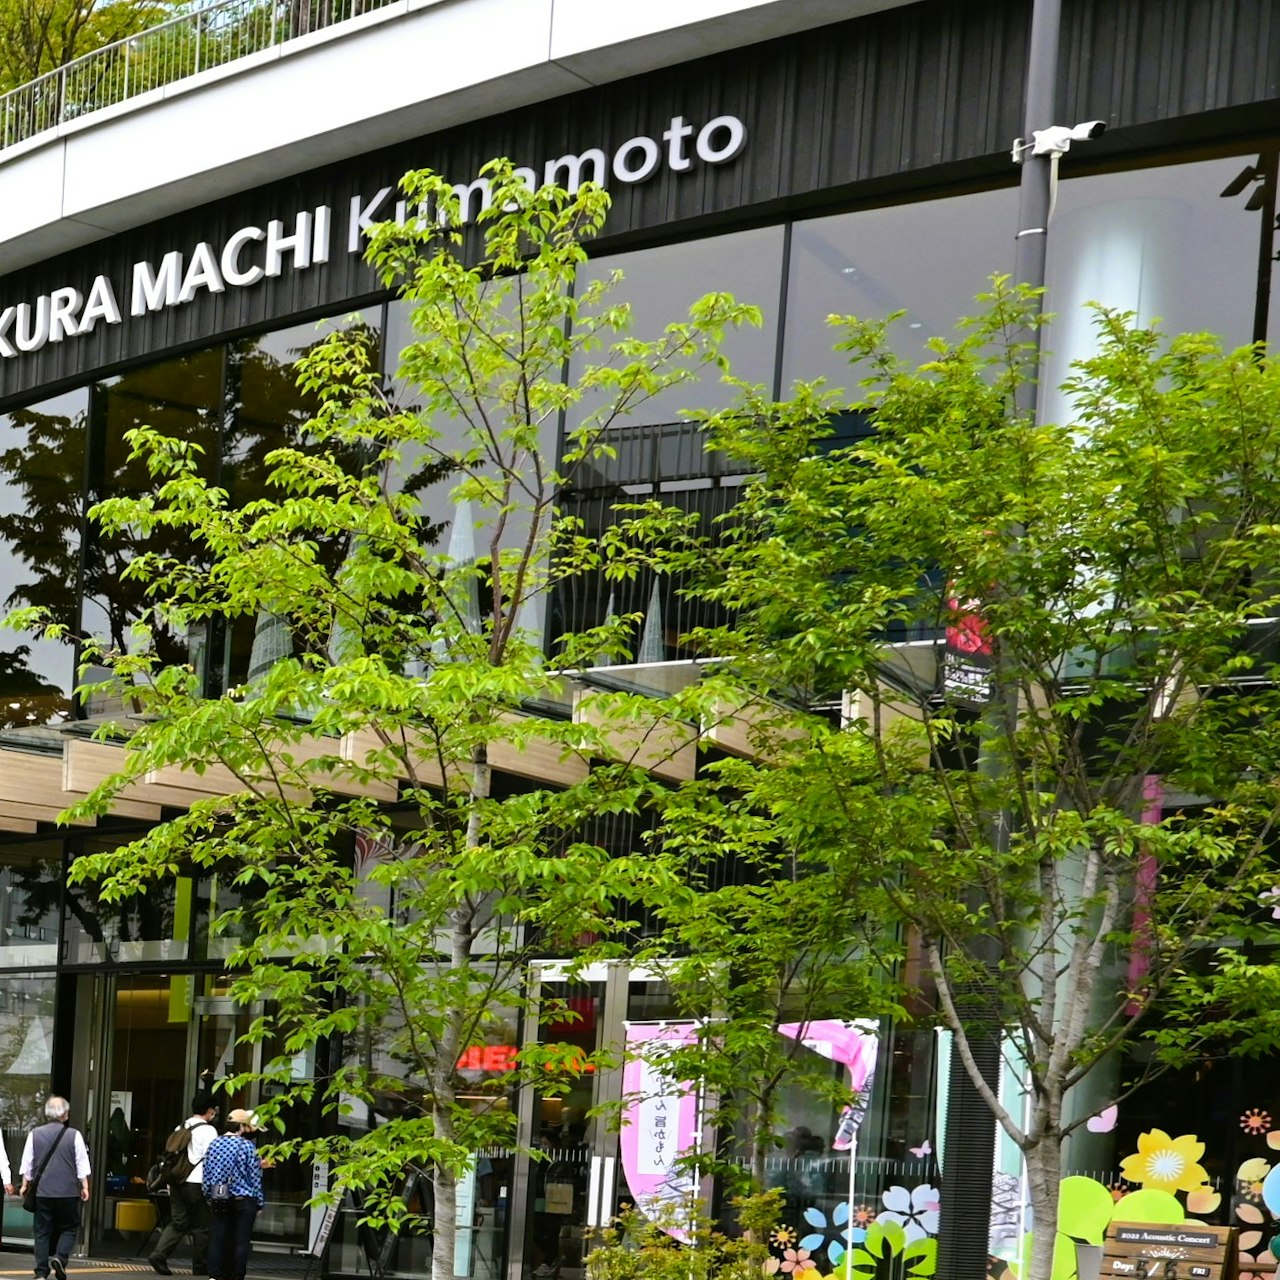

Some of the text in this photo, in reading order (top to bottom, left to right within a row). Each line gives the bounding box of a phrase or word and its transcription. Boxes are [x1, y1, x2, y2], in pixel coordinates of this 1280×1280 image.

[130, 204, 332, 318] MACHI
[1141, 1232, 1177, 1242] Acoustic
[1177, 1234, 1211, 1245] Concert
